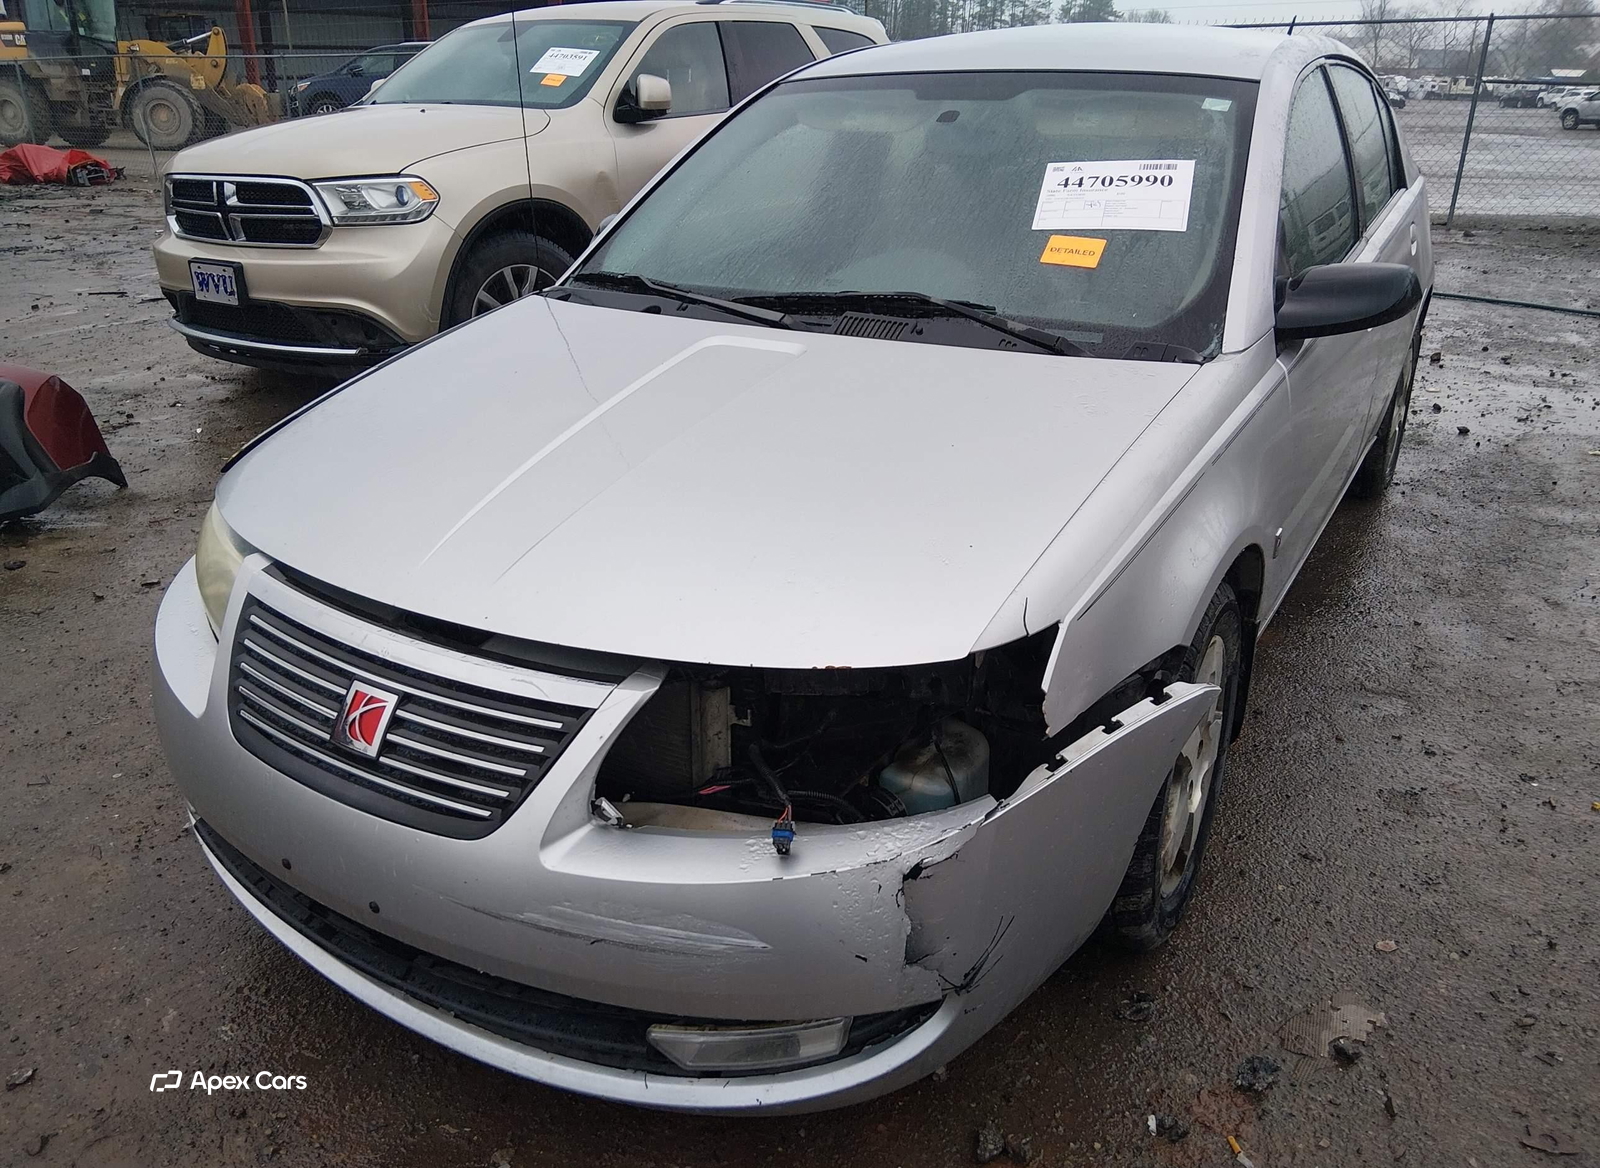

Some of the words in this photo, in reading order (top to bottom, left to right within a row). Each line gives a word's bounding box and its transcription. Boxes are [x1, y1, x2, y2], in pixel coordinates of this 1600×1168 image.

[1057, 174, 1174, 189] 44705990
[1050, 246, 1096, 257] DETAILED
[194, 271, 236, 296] WVU
